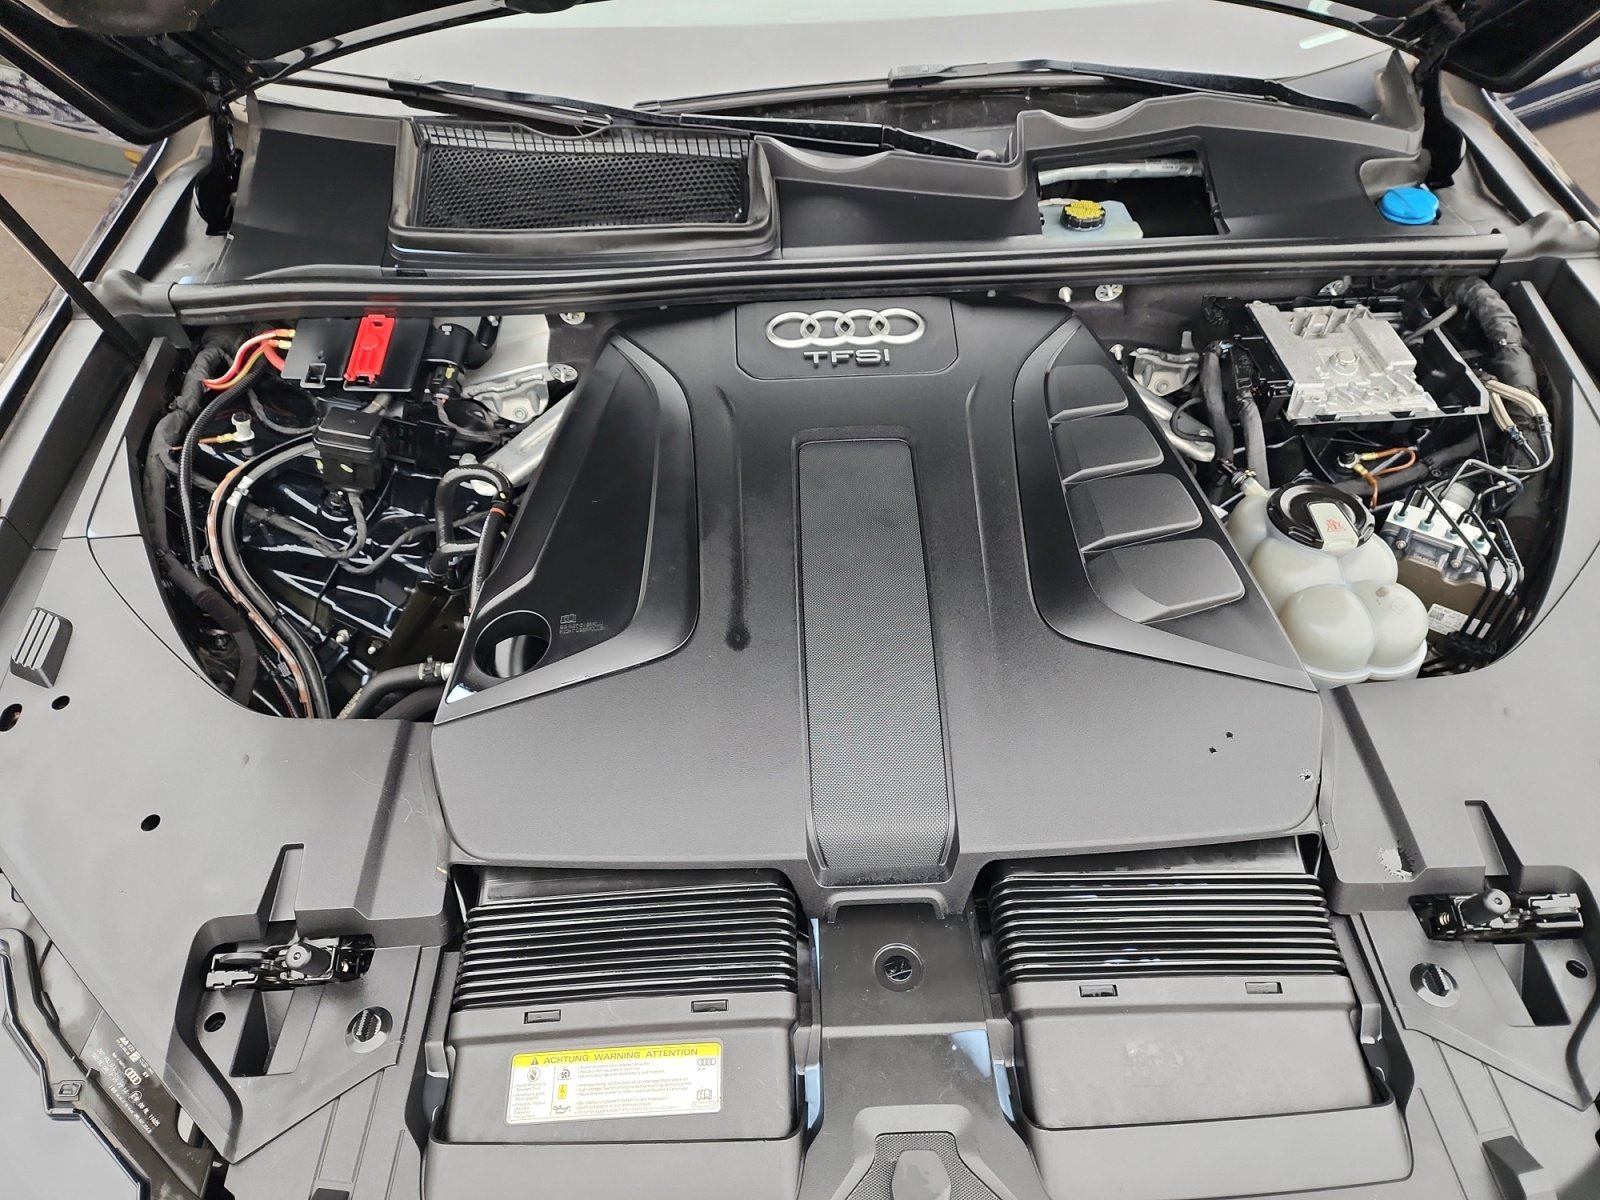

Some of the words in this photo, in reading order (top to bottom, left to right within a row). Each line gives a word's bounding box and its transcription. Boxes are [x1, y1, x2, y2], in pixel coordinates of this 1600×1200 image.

[803, 348, 890, 366] TFSI
[543, 1054, 589, 1065] ACHTUNG
[594, 1051, 641, 1061] WARNING
[645, 1048, 698, 1059] ATTENTION
